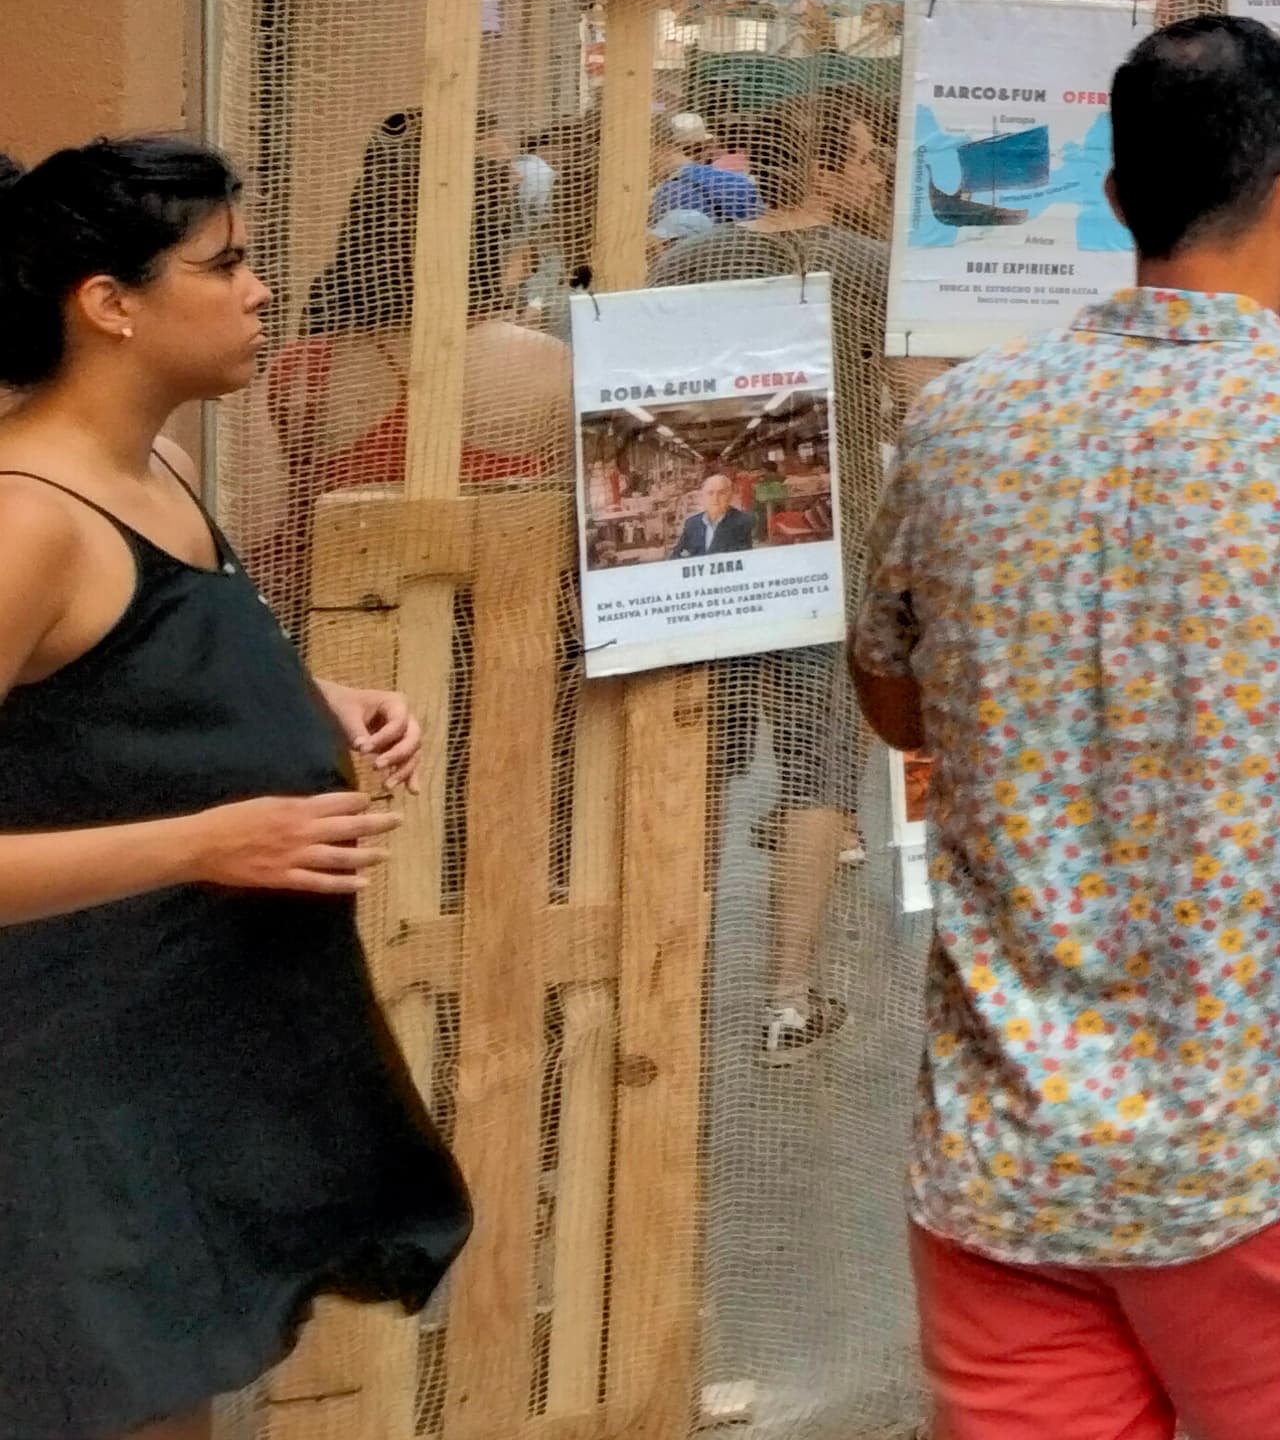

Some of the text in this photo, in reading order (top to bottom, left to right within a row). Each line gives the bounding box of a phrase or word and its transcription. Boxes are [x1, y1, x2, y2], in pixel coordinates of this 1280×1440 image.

[933, 84, 1111, 105] BARCO&FUN OFER
[967, 262, 1075, 276] BOAT EXPIRIENCE
[600, 371, 808, 403] ROBA &FUN OFERTA
[682, 559, 744, 579] DIY ZARA
[753, 581, 765, 590] DE
[768, 572, 829, 588] PRODUCCIÓ
[598, 610, 641, 623] MASSIVA
[651, 602, 704, 616] PARTICIPA
[706, 599, 719, 608] DE
[802, 586, 815, 596] DE
[817, 585, 830, 594] LA
[666, 615, 690, 625] TEVA
